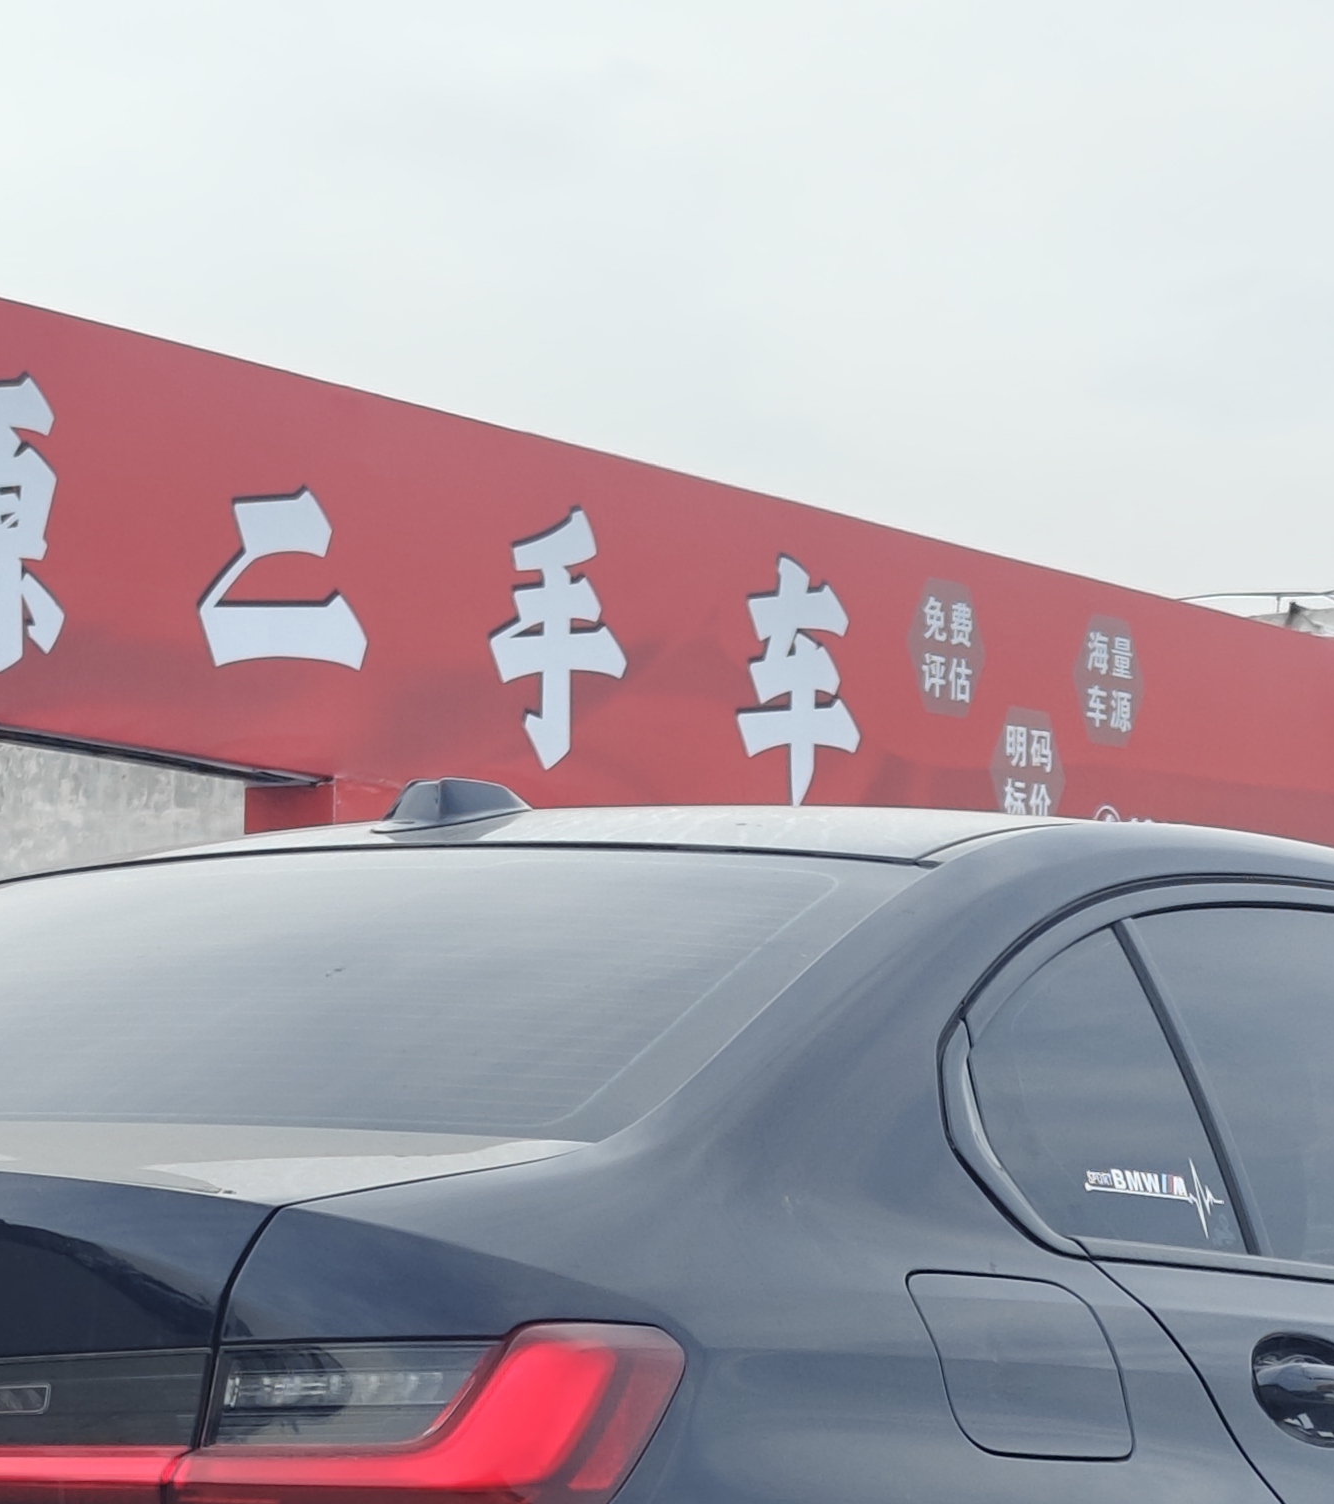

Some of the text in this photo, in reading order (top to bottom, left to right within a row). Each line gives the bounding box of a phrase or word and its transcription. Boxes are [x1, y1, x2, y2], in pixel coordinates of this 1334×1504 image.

[923, 596, 973, 648] 免费
[922, 652, 973, 704] 评估
[1087, 631, 1134, 680] 海量
[1086, 685, 1133, 733] 车源
[1005, 725, 1053, 773] 明码
[1004, 778, 1052, 816] 标价
[1110, 1168, 1161, 1194] BMW
